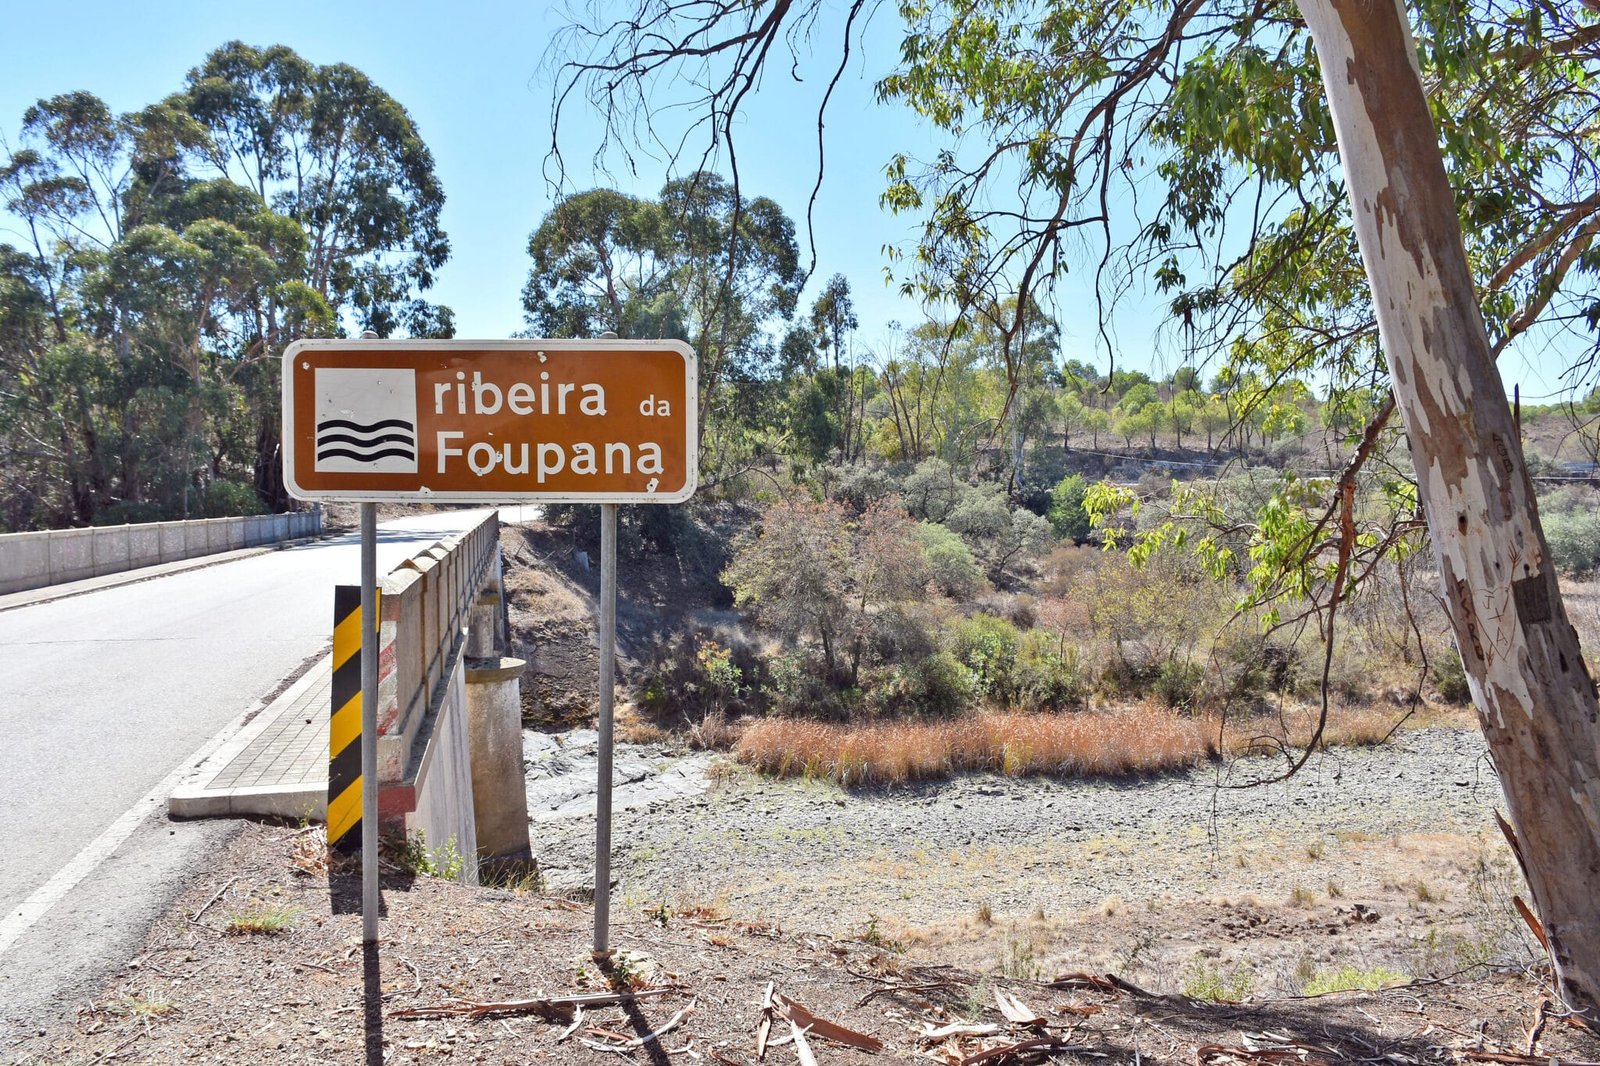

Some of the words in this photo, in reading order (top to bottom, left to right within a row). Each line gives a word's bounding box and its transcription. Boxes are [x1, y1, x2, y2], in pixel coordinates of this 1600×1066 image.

[434, 371, 608, 417] ribeira
[639, 394, 671, 417] da
[436, 430, 665, 484] Foupana
